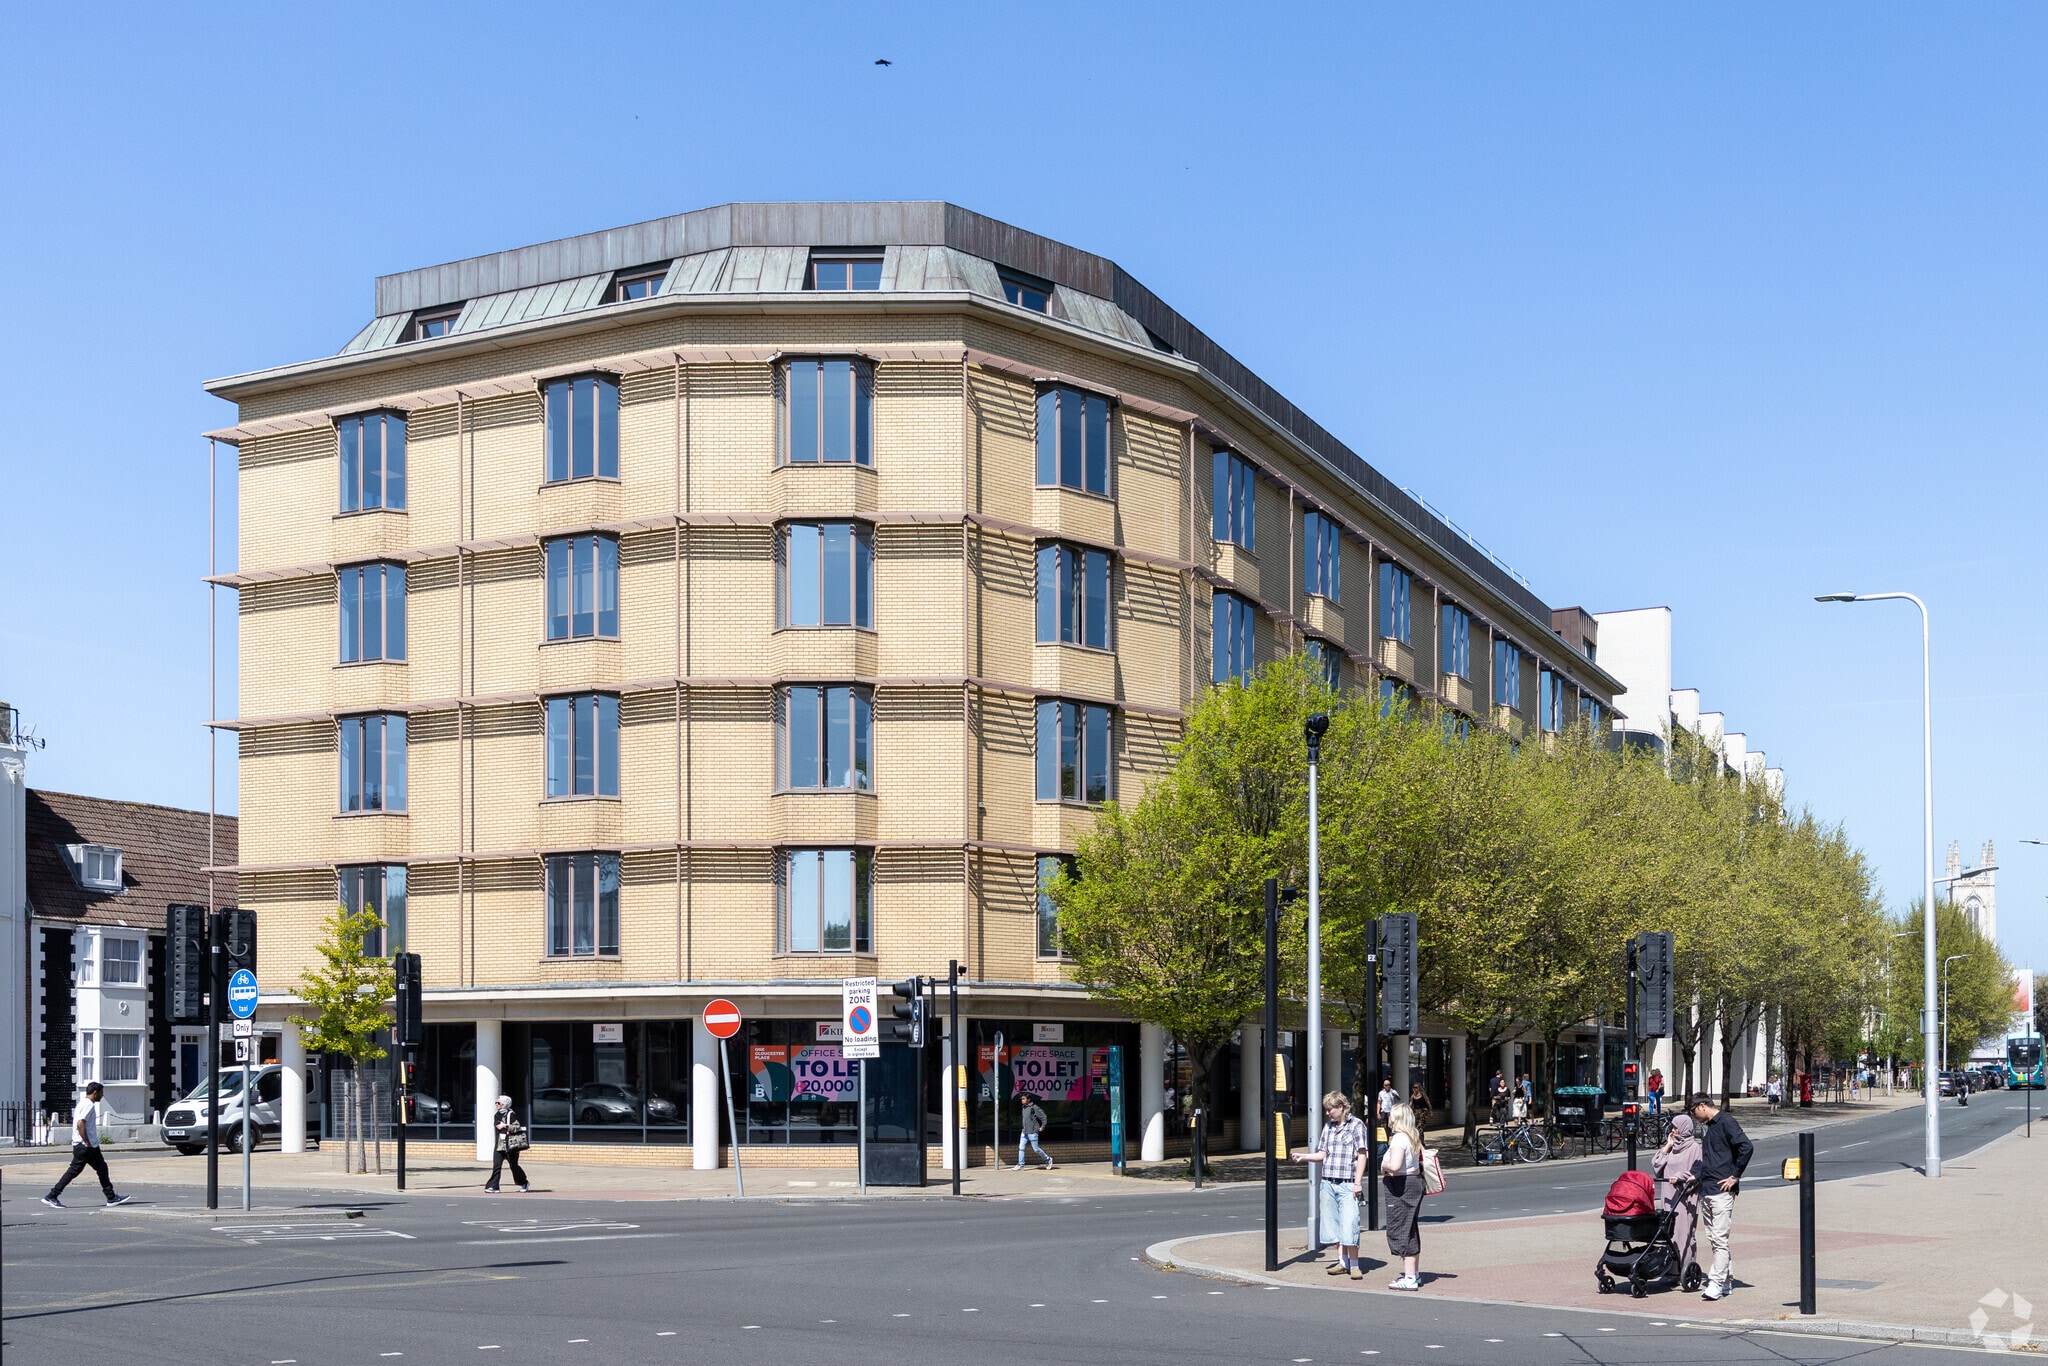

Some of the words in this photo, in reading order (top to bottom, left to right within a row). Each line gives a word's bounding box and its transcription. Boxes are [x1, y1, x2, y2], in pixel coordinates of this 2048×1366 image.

[845, 979, 874, 987] Restricted
[849, 996, 870, 1004] ZONE
[236, 1023, 249, 1032] Only
[800, 1049, 835, 1057] OFFICE
[1019, 1050, 1047, 1058] OFFICE
[1049, 1050, 1075, 1058] SPACE
[796, 1060, 829, 1077] TO
[1015, 1060, 1042, 1077] TO
[1045, 1060, 1079, 1077] LET
[802, 1080, 854, 1094] 20,000
[1019, 1079, 1062, 1094] 20,000
[755, 1087, 765, 1098] B
[982, 1087, 990, 1097] B
